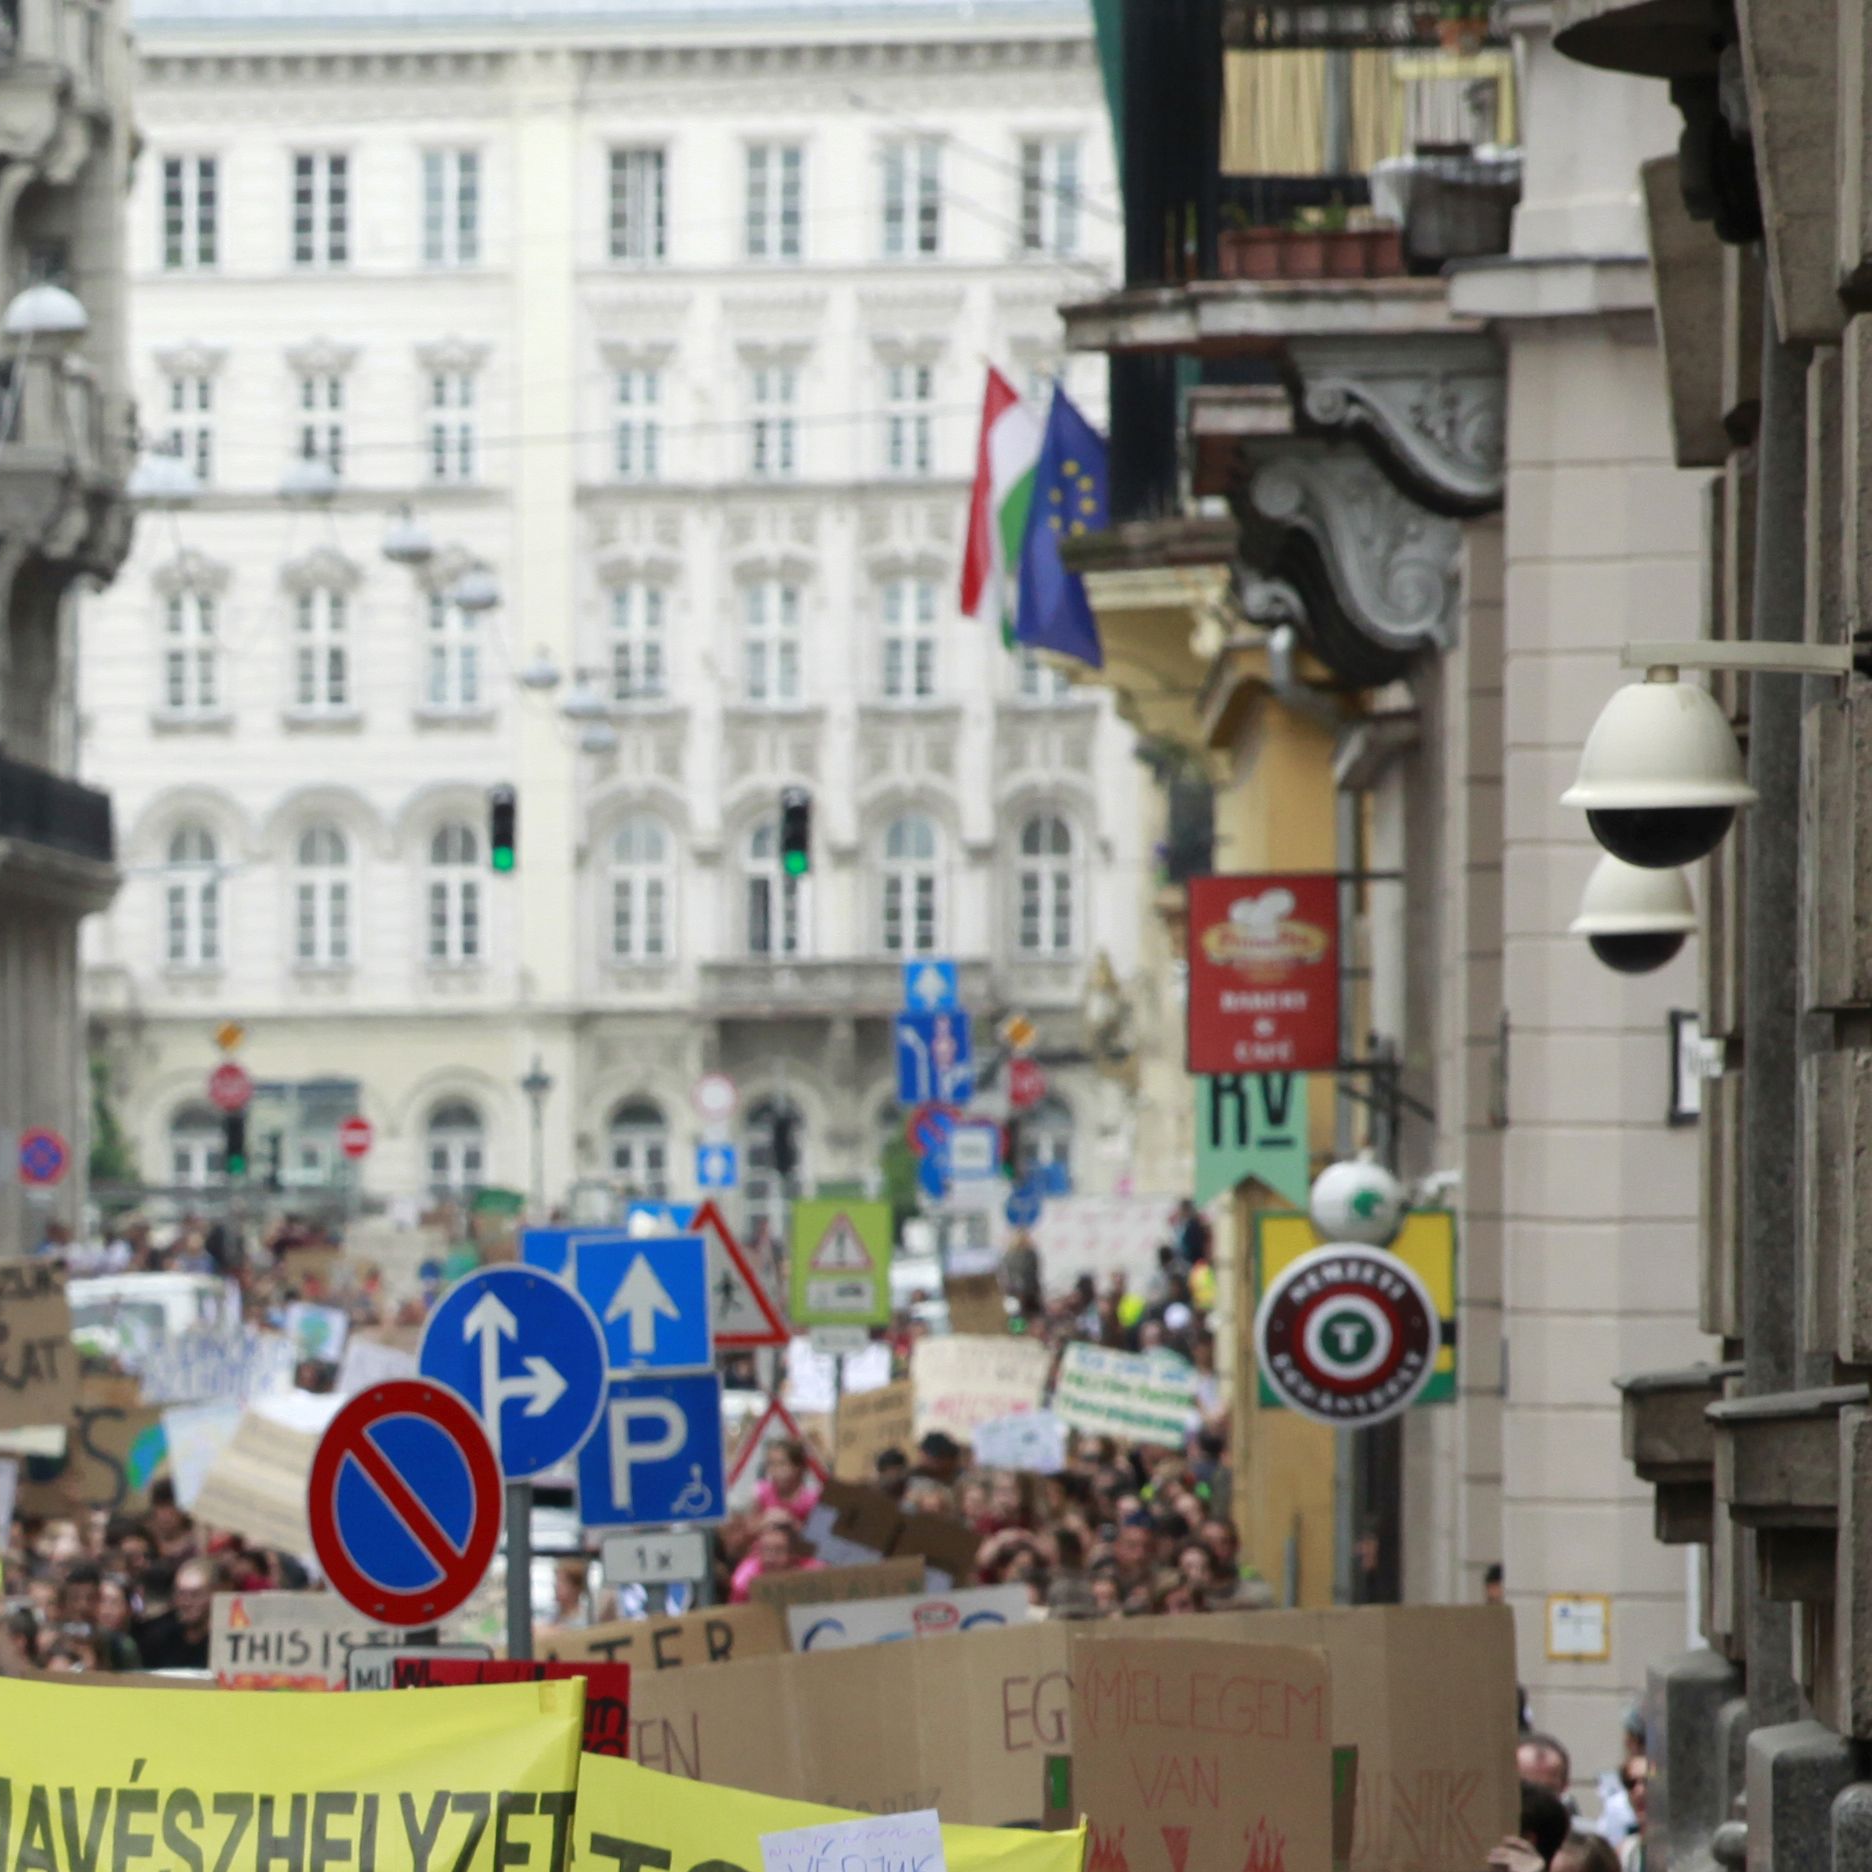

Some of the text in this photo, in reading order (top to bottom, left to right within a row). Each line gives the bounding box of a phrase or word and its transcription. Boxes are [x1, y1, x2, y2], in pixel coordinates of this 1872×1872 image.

[1331, 1322, 1365, 1355] T
[608, 1397, 688, 1511] P
[226, 1628, 312, 1667] THIS
[1129, 1754, 1219, 1810] VAN
